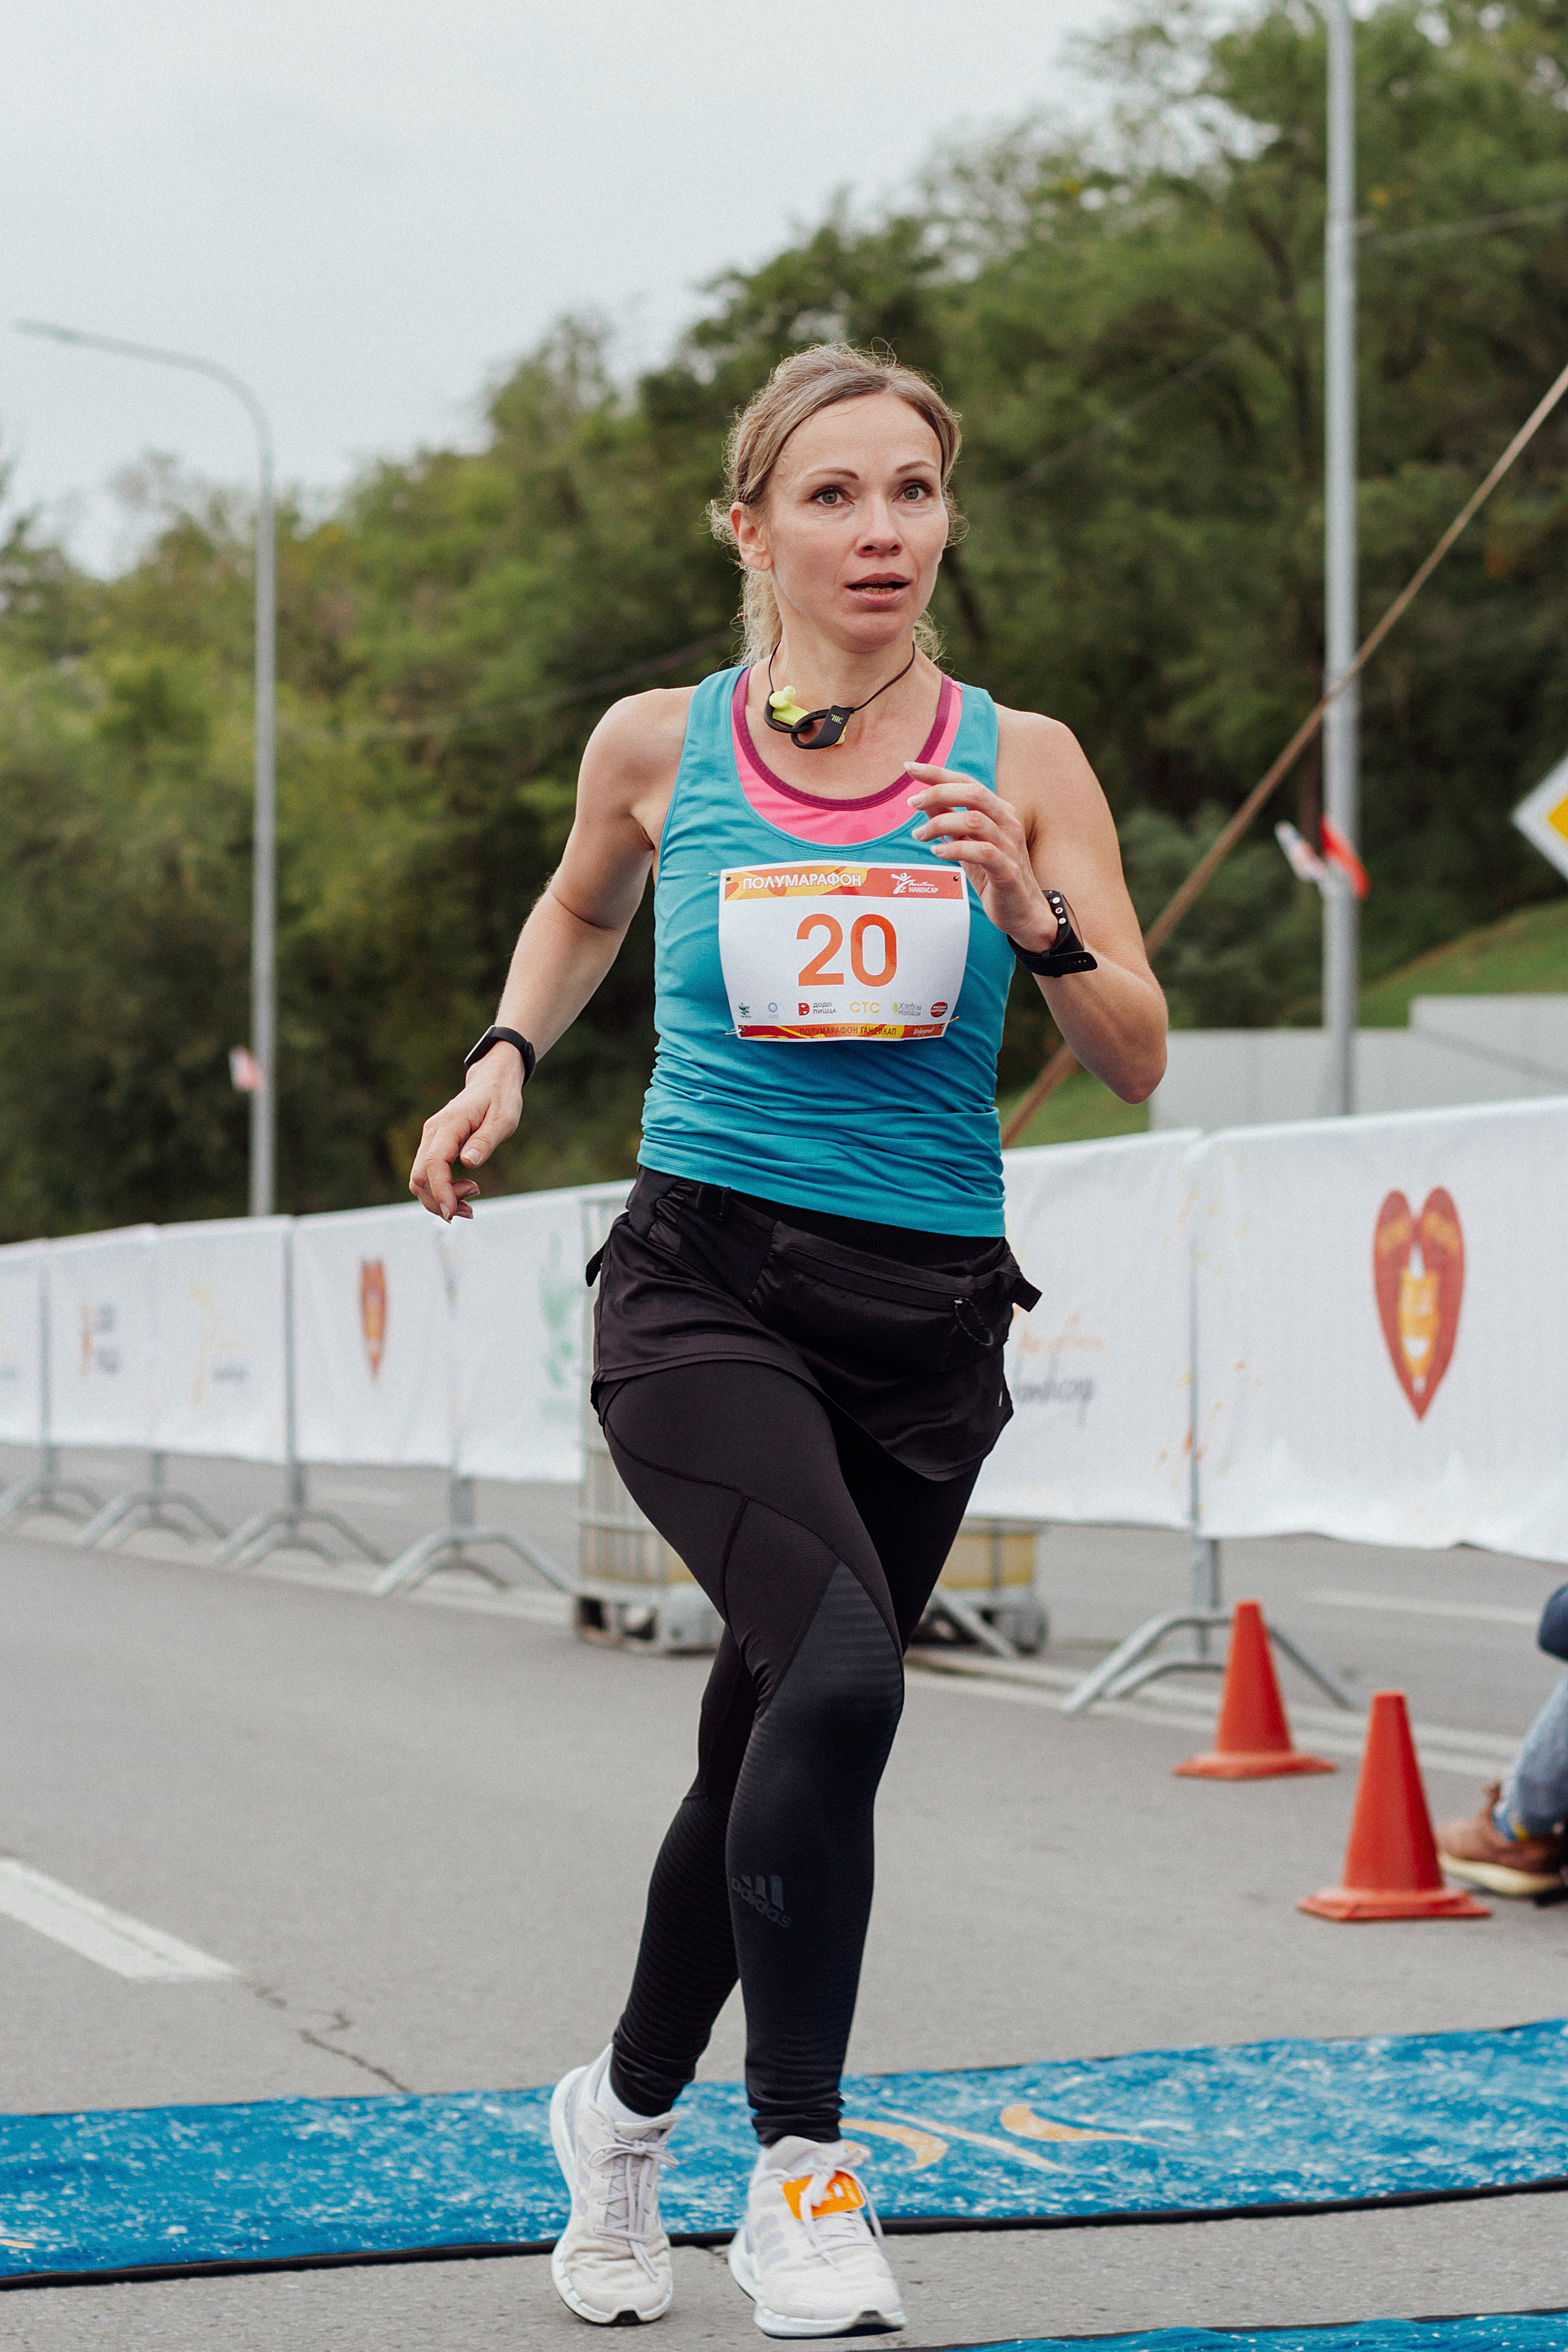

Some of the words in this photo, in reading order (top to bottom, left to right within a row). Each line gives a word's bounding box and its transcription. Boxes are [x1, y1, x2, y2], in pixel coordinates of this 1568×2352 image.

[742, 872, 862, 890] ПОЛУМАРАФОН
[796, 913, 897, 987] 20
[850, 1001, 880, 1014] СТС
[800, 1027, 858, 1035] ПОЛУМАРАФОН
[860, 1026, 897, 1036] ГАНДИКАП
[731, 1876, 793, 1929] adidas
